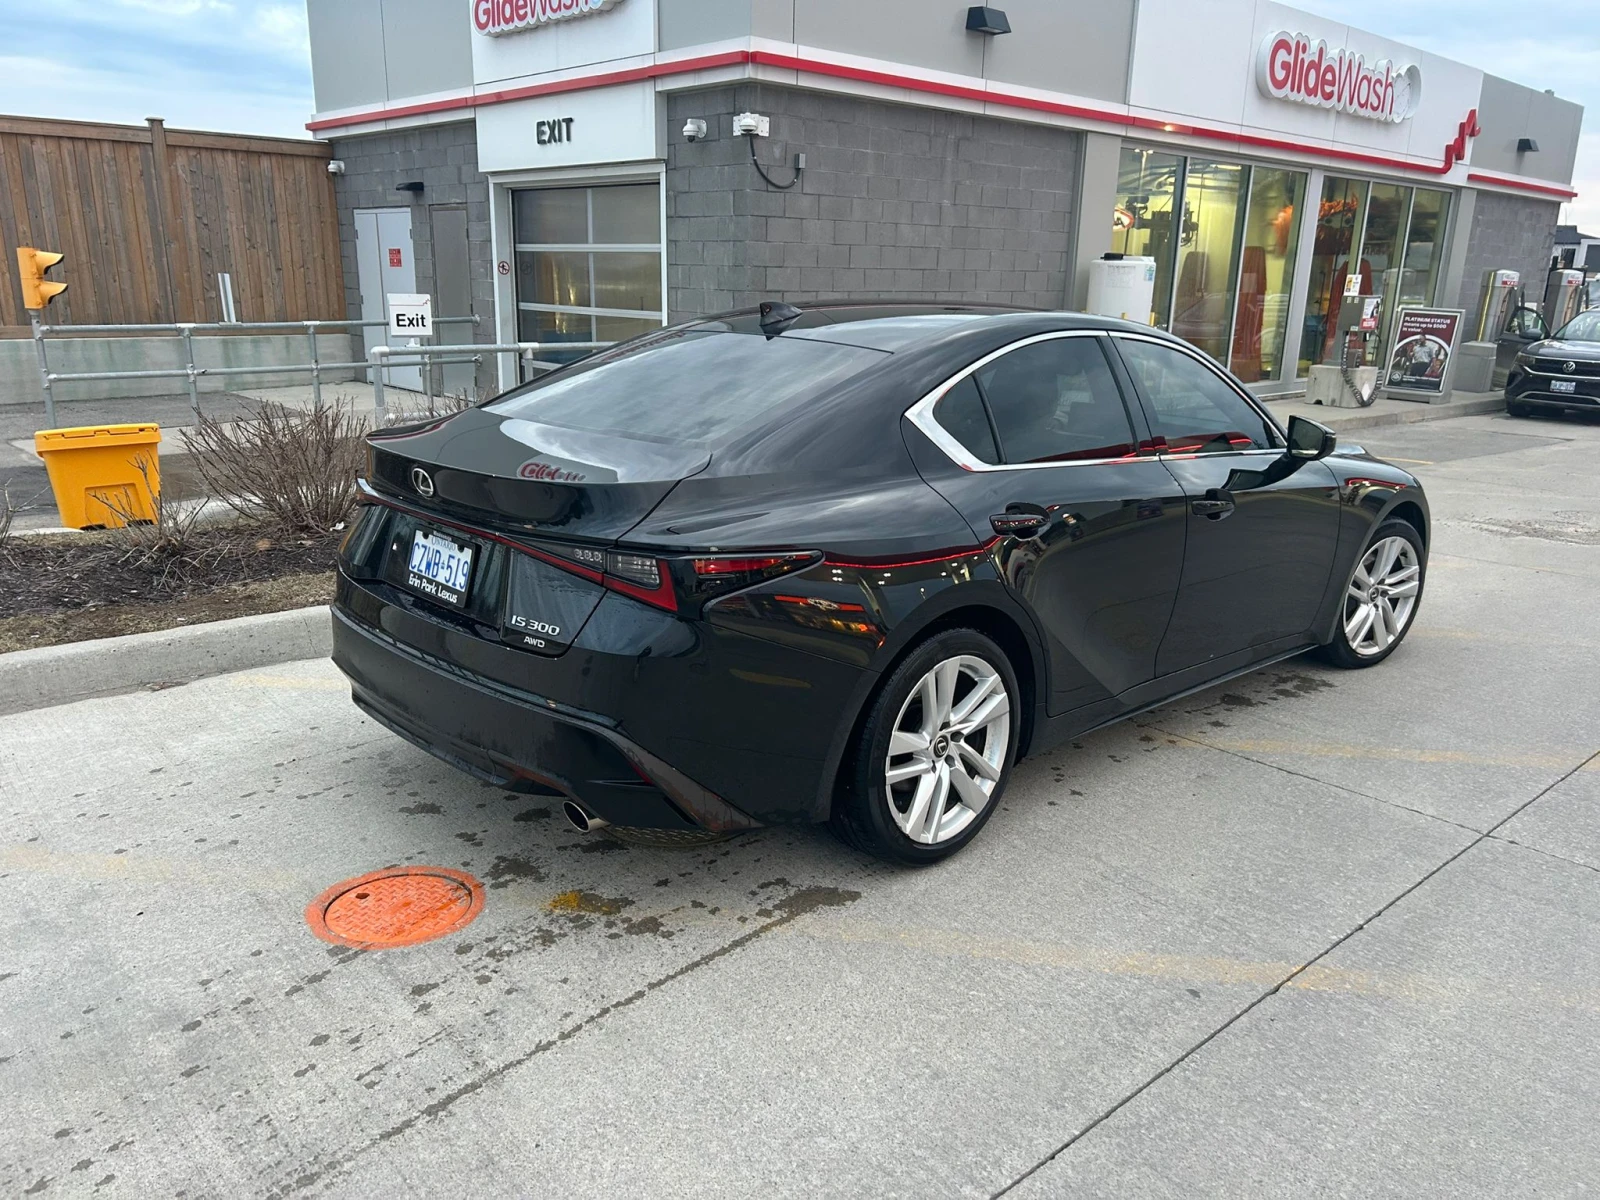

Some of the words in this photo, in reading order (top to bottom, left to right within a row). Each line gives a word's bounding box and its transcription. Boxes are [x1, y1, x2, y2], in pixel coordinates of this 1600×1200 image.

[474, 0, 588, 30] GlideWa
[1269, 38, 1395, 115] GlideWash
[536, 117, 575, 145] EXIT
[396, 313, 426, 327] Exit
[408, 573, 421, 588] Erin
[421, 578, 437, 597] Park
[438, 585, 458, 603] Lexus
[511, 615, 526, 627] IS
[528, 619, 560, 636] 300
[523, 636, 545, 648] AWD
